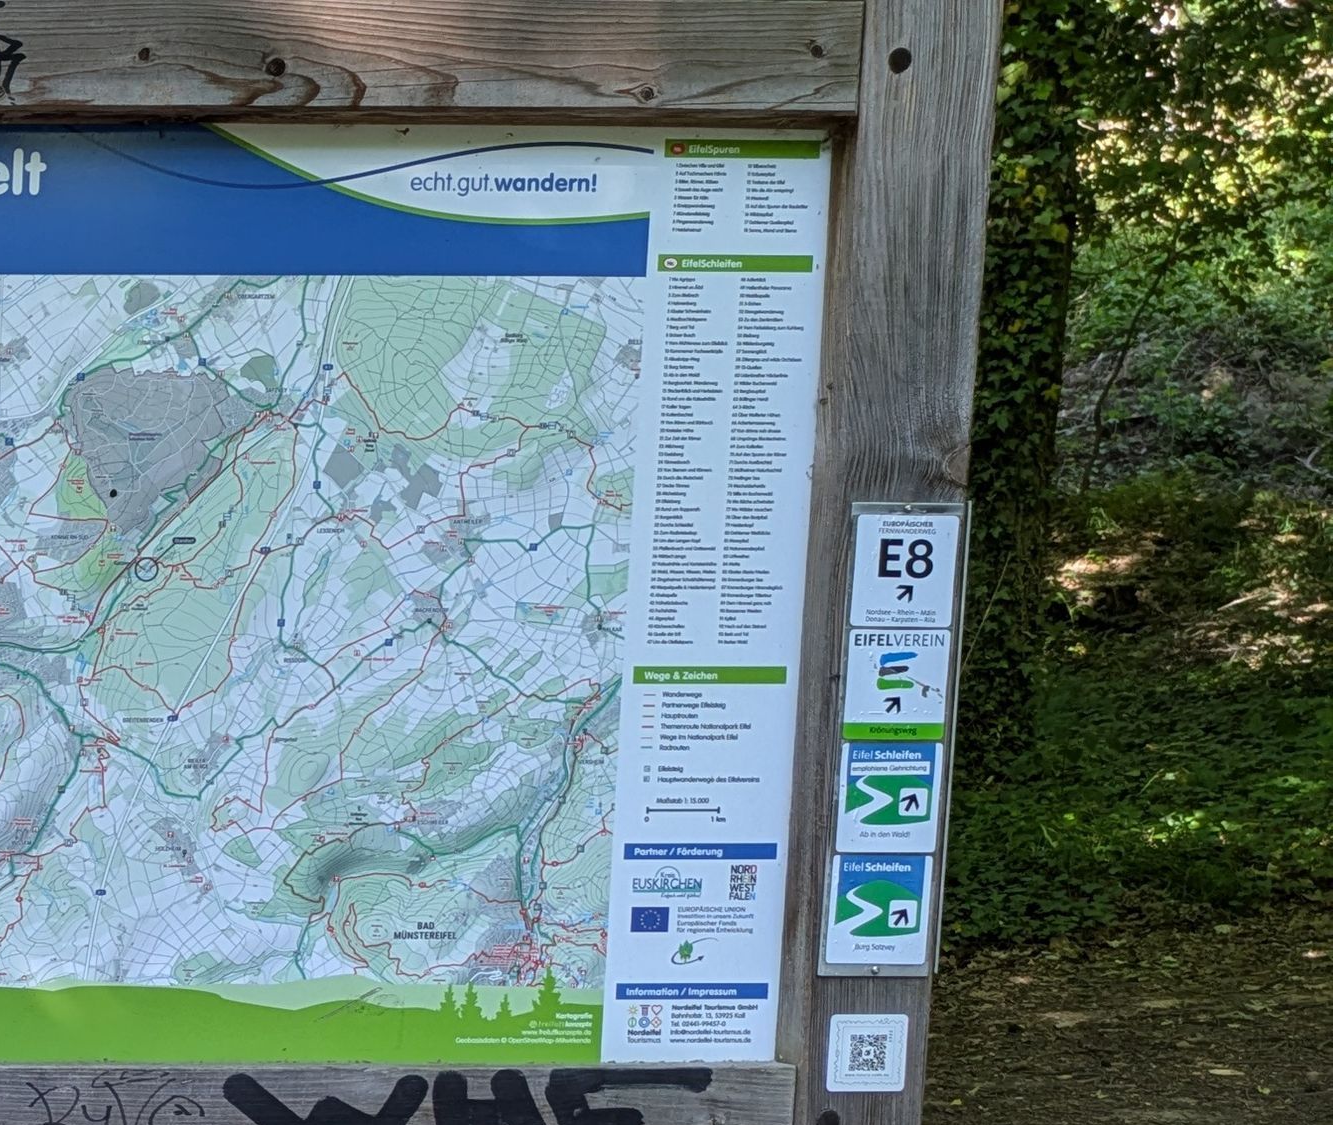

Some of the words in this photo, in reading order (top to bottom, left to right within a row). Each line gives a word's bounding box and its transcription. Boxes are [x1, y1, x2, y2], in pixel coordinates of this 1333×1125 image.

[688, 145, 741, 155] EifelSpuren
[410, 171, 598, 197] echt.gut.wandern!
[681, 259, 742, 269] EifelSchleifen
[882, 520, 933, 528] EUROPÄISCHER
[878, 538, 934, 579] E8
[854, 633, 945, 647] EIFELVEREIN
[644, 671, 670, 681] Wege
[672, 671, 680, 680] &
[682, 671, 718, 680] Zeichen
[662, 691, 703, 699] Wanderwege
[661, 702, 700, 710] Partnerwege
[700, 723, 738, 731] Nationalpark
[869, 727, 918, 736] Krönungsweg
[852, 750, 873, 760] Eifel
[874, 750, 922, 760] Schleifen
[889, 764, 927, 772] Gehrichtung
[657, 776, 715, 784] Hauptwanderwege
[634, 847, 668, 856] Partner
[677, 847, 724, 858] Förderung
[731, 864, 757, 874] NORD
[843, 862, 864, 872] Eifel
[865, 862, 912, 872] Schleifen
[730, 874, 757, 883] RHEIN
[632, 878, 703, 890] EUSKIRCHEN
[729, 883, 756, 892] WEST
[729, 892, 756, 900] FALEN
[417, 922, 435, 930] BAD
[393, 930, 457, 940] MÜNSTEREIFEL
[626, 988, 679, 996] Information
[688, 988, 737, 997] Impressum
